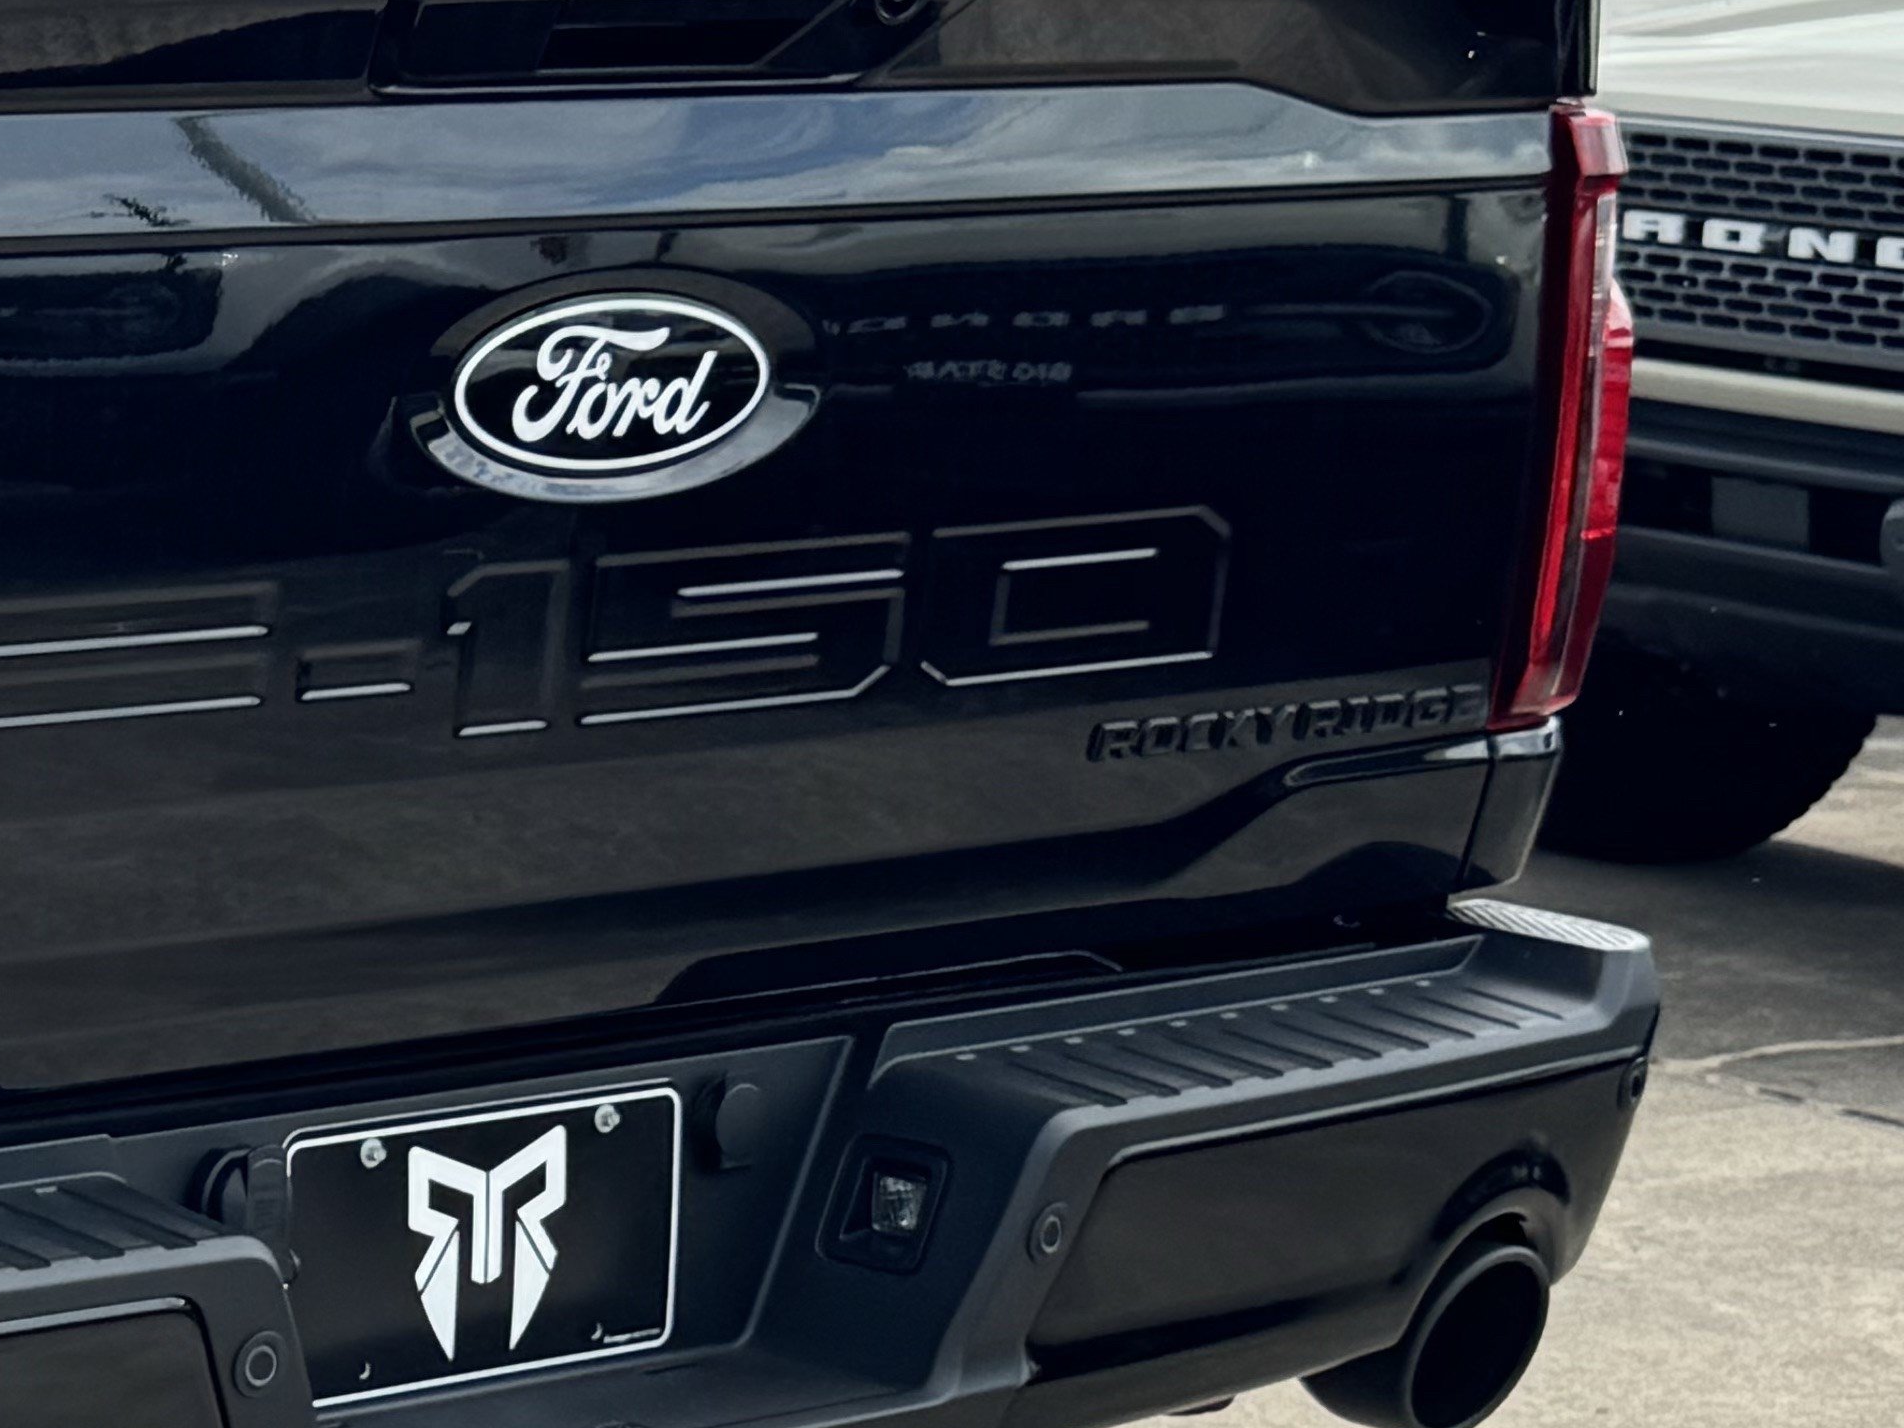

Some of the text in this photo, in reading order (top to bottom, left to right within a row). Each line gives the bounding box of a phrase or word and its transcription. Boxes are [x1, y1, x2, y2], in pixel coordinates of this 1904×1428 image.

[510, 324, 720, 442] Ford
[1086, 683, 1482, 762] ROCKY RIDGE
